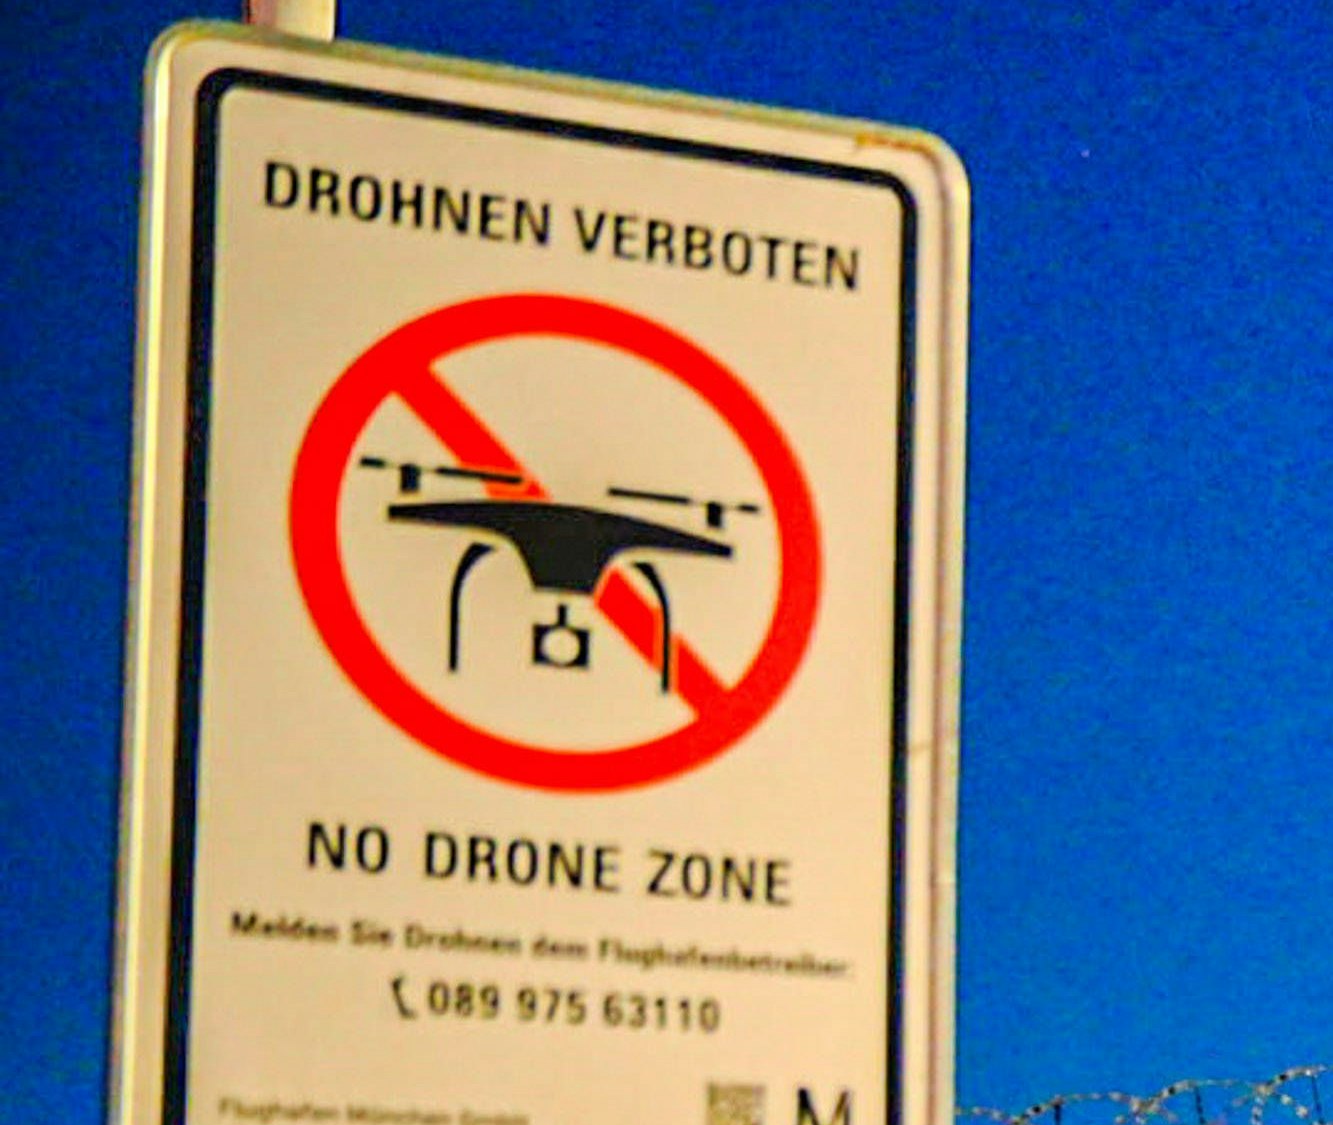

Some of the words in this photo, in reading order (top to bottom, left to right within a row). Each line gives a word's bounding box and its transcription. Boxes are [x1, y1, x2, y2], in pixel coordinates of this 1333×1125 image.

[264, 160, 552, 246] DROHNEN
[573, 206, 860, 291] VERBOTEN
[306, 822, 391, 875] NO
[423, 831, 623, 893] DRONE
[646, 850, 794, 907] ZONE
[352, 920, 393, 946] Sie
[404, 924, 521, 953] Drohnen
[428, 980, 500, 1020] 089
[517, 986, 587, 1026] 975
[603, 991, 721, 1033] 63110
